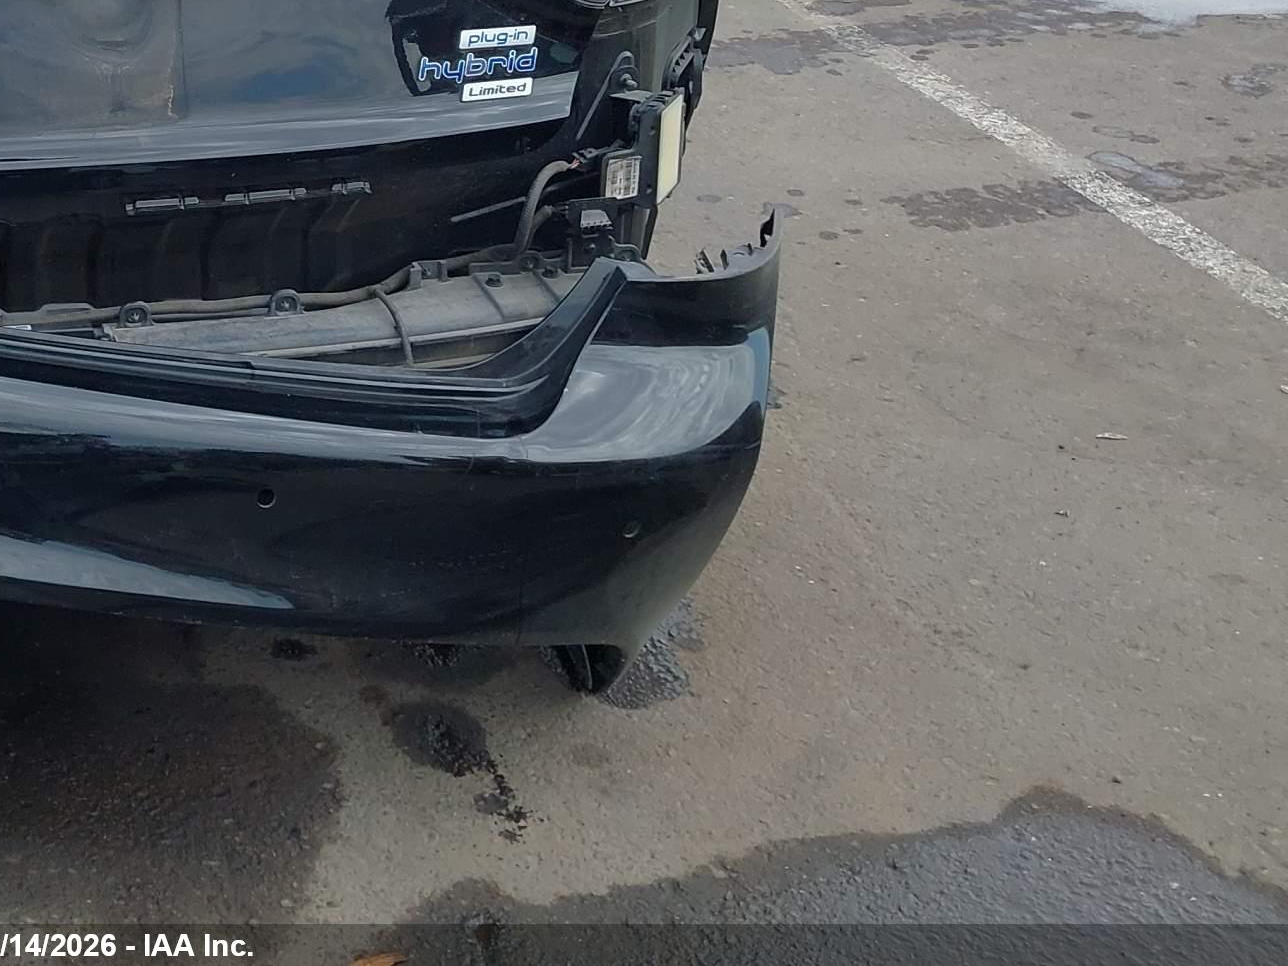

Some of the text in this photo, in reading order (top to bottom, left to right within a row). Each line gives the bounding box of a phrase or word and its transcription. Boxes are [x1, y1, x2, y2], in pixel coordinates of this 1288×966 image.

[467, 28, 529, 48] plug-in
[418, 46, 538, 84] hybrid
[468, 82, 527, 97] Limited
